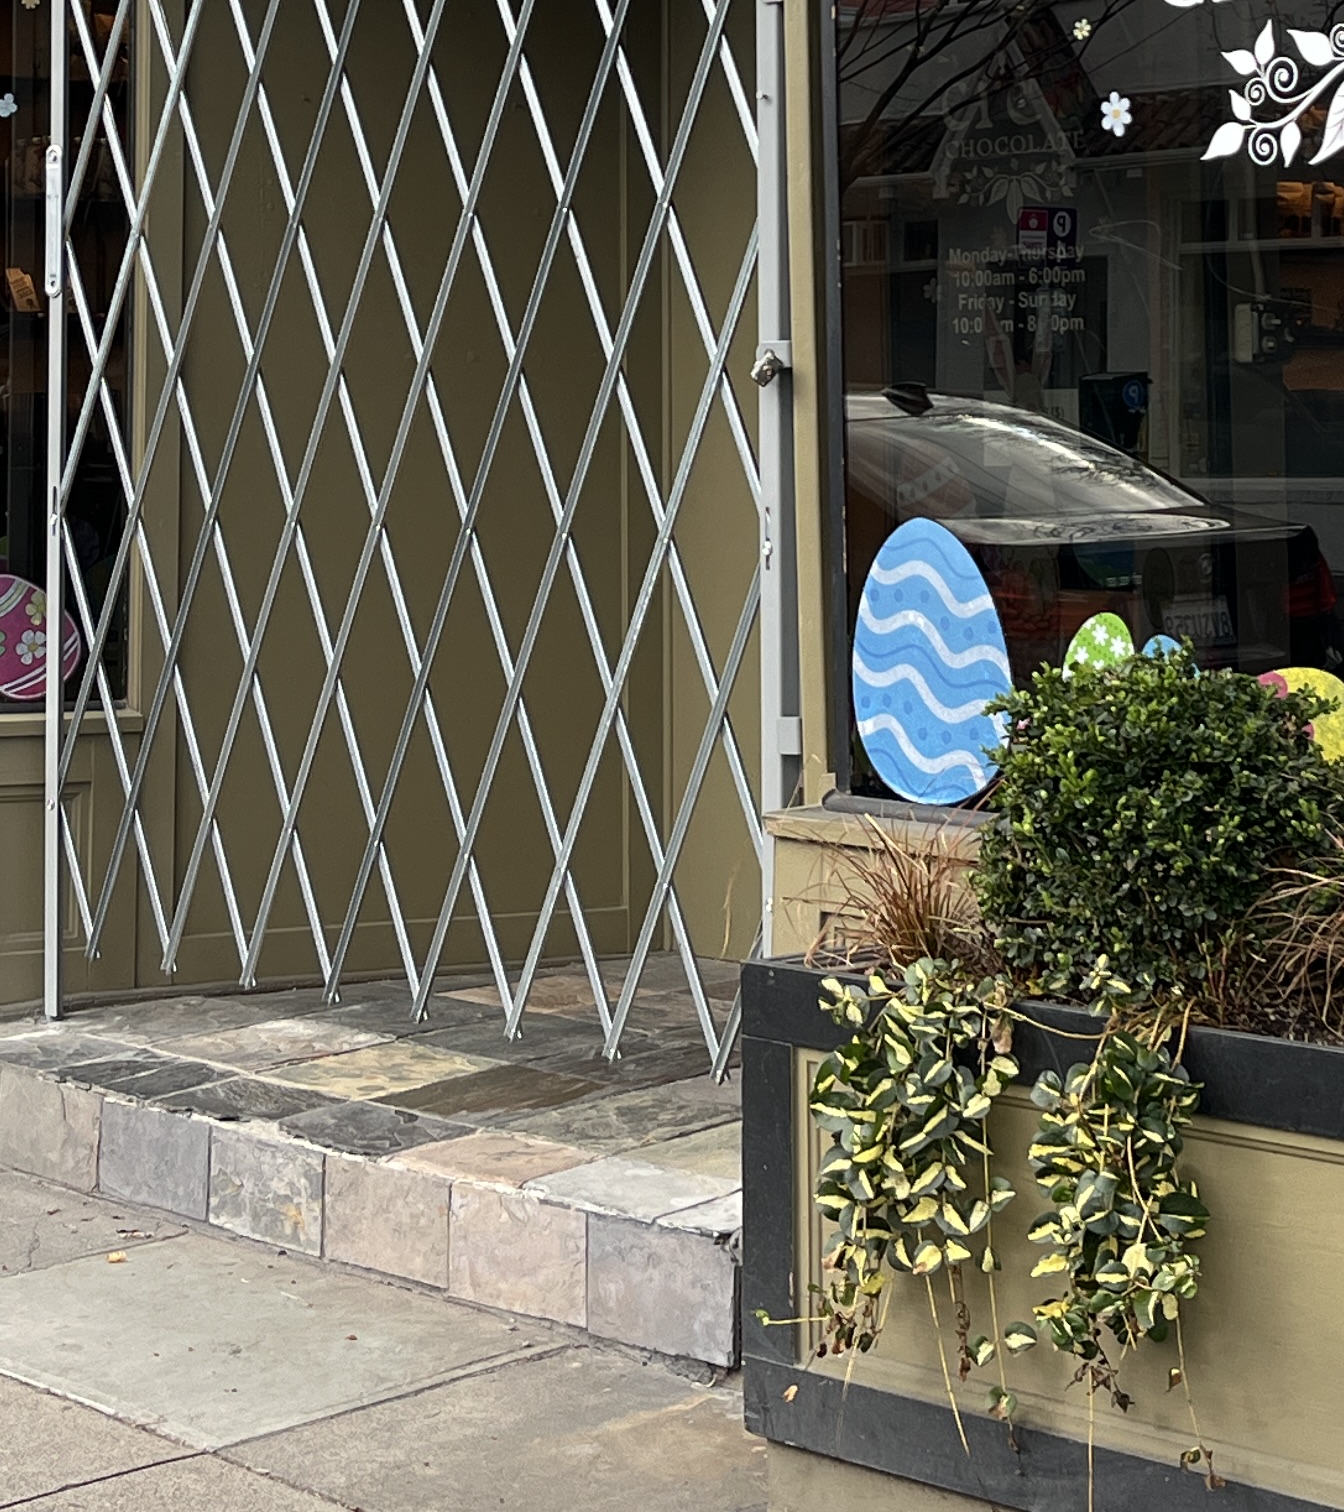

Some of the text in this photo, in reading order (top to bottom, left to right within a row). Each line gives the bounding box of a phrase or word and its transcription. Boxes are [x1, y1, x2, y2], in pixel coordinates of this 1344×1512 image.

[945, 129, 1086, 159] CHOCOLATE
[955, 269, 1015, 287] 10:00am
[1028, 266, 1086, 286] 6:00pm
